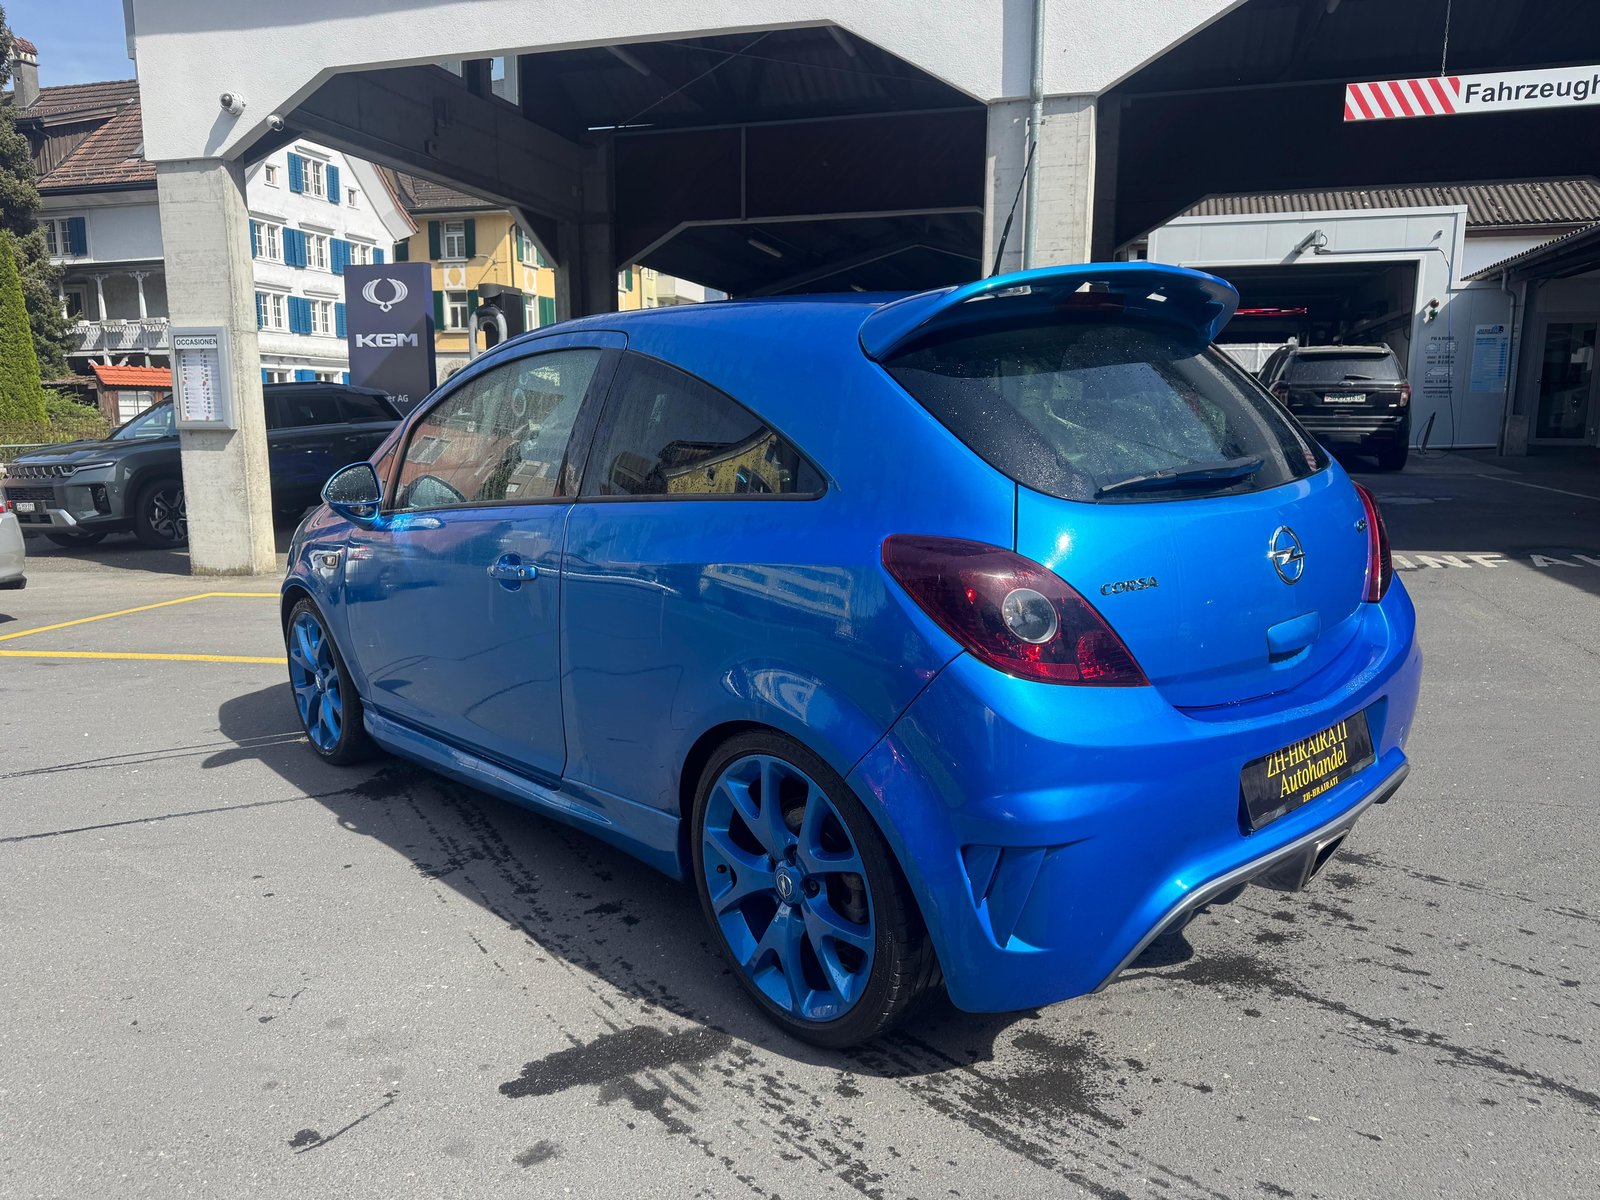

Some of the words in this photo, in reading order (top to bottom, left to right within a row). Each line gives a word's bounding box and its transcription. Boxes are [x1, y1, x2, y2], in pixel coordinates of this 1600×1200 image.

[176, 338, 218, 346] OCCASIONEN
[355, 333, 419, 348] KGM
[397, 394, 409, 402] AG
[1100, 577, 1159, 596] CORSA
[1280, 742, 1348, 798] Autohandel
